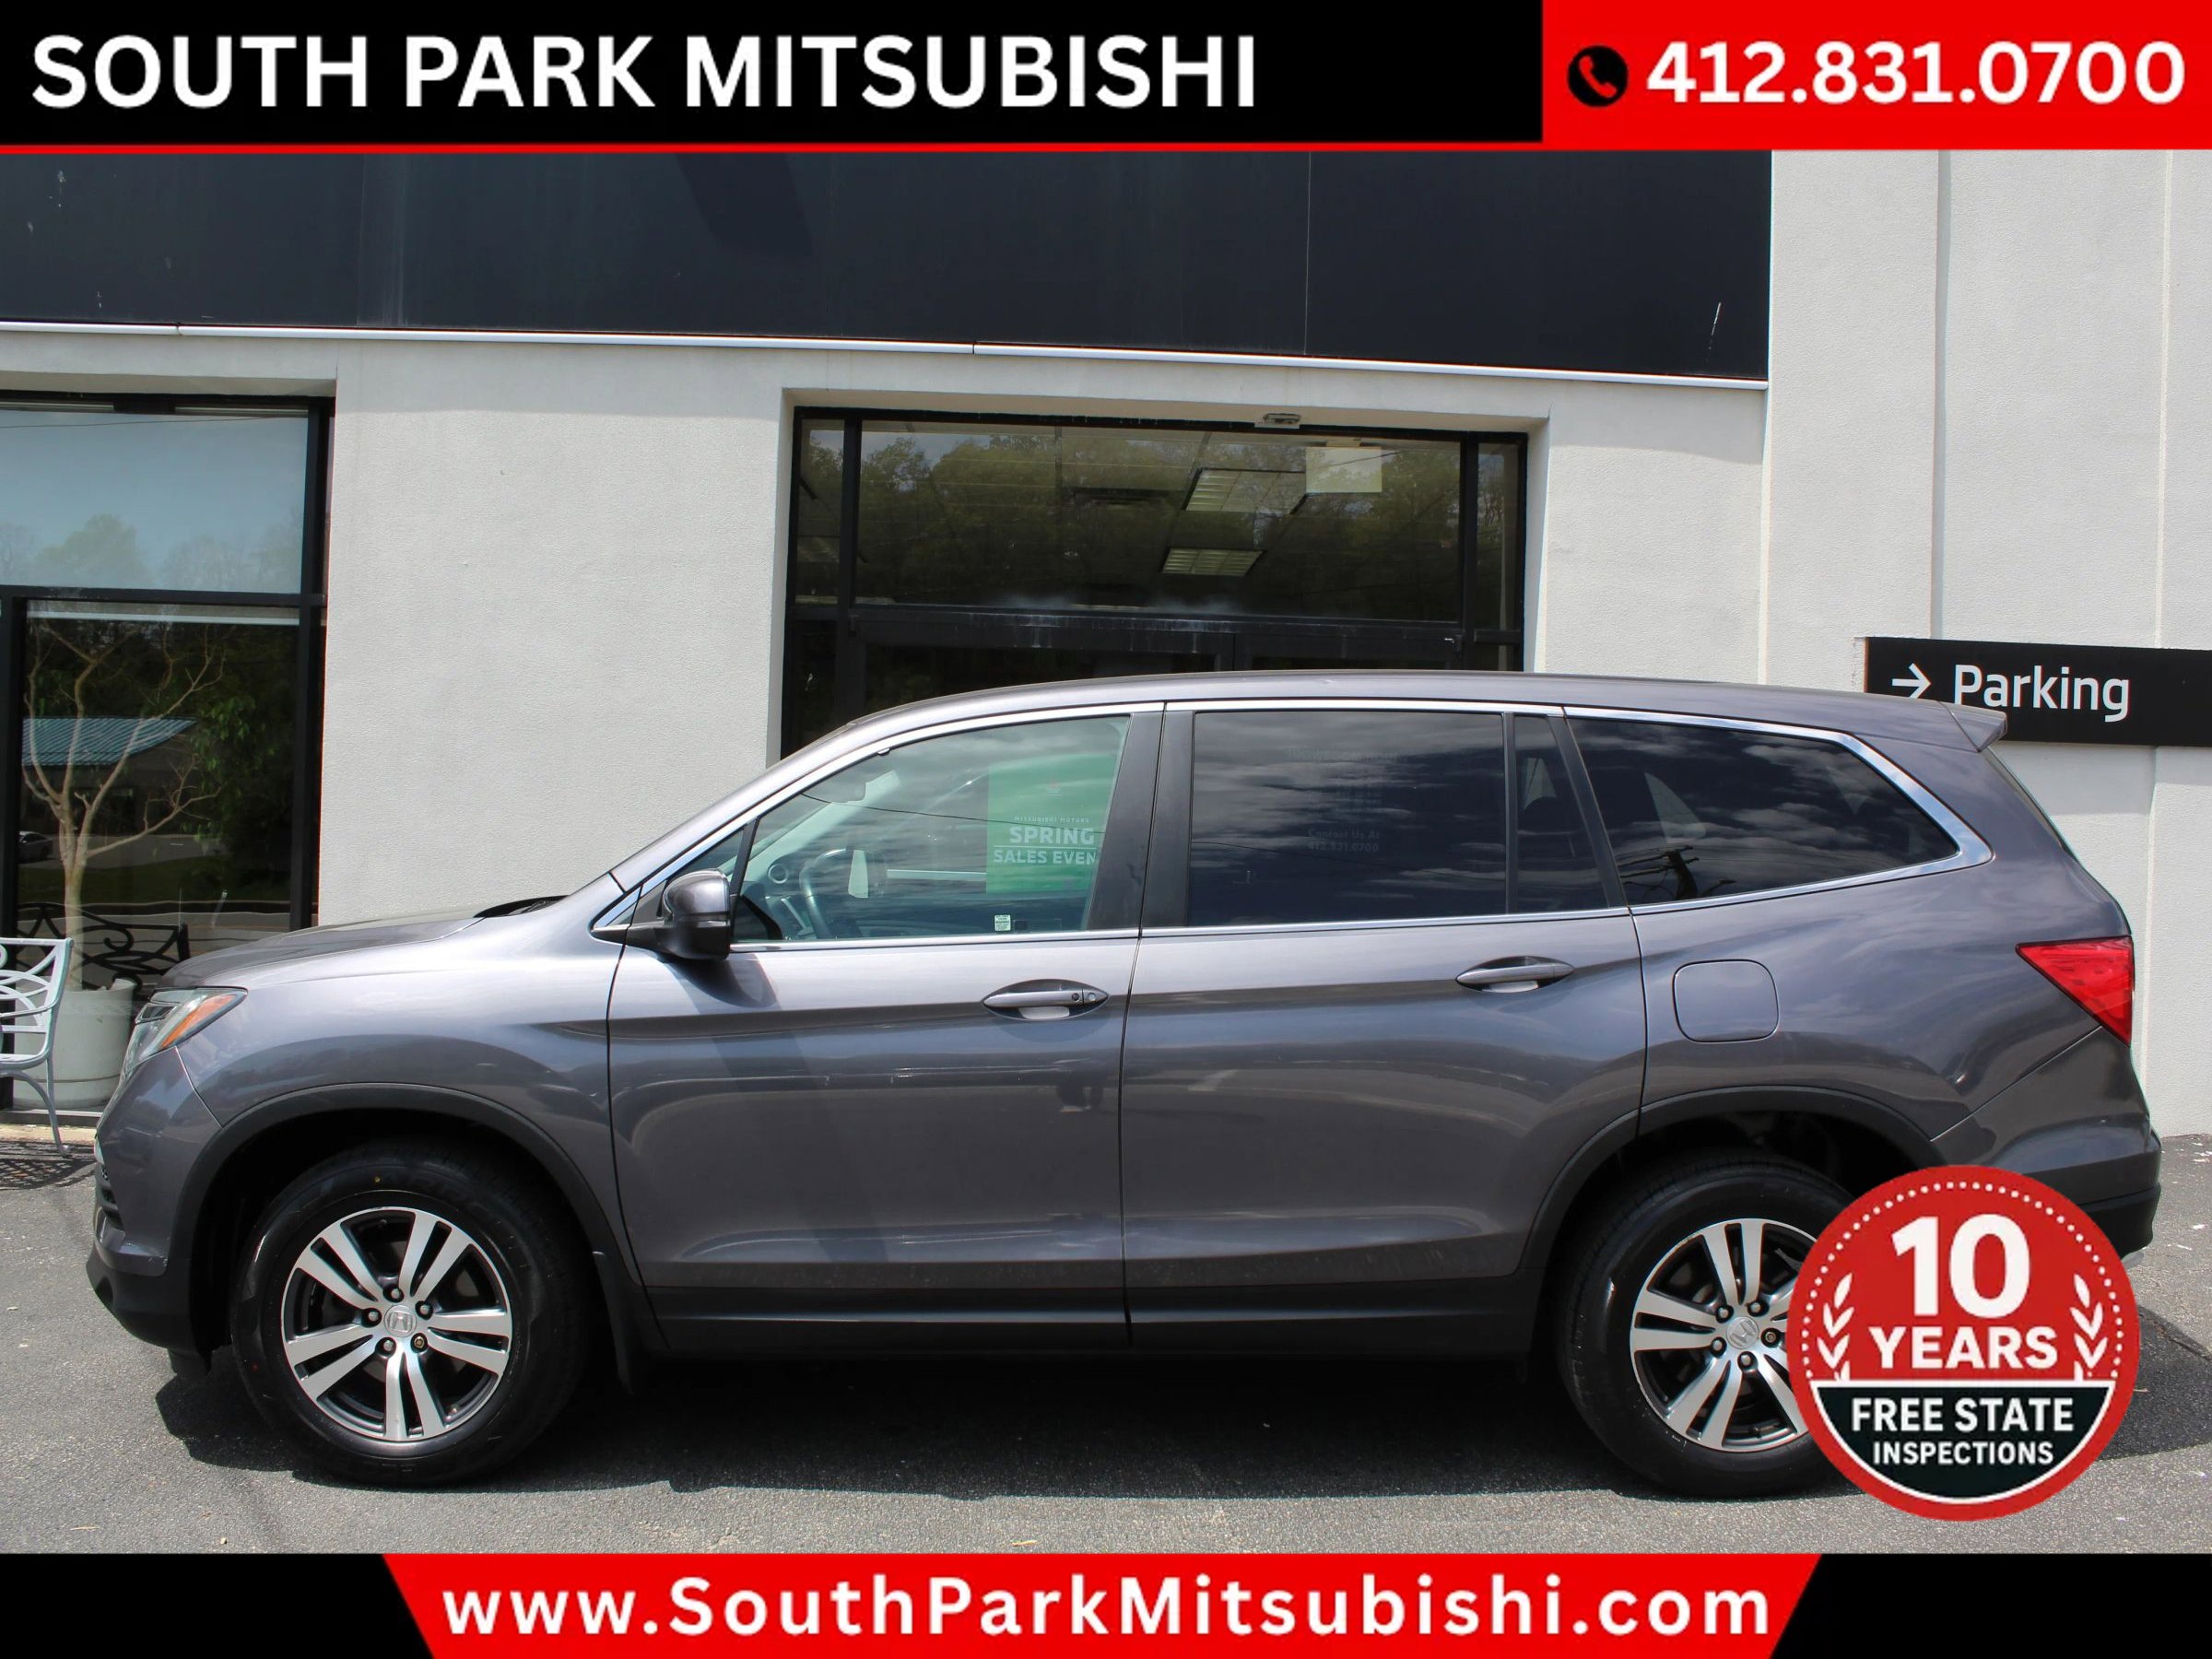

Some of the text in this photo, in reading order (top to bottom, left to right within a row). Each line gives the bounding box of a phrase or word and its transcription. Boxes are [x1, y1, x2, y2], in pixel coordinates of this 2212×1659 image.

[1954, 664, 2130, 723] Parking
[1009, 826, 1095, 845] SPRING
[993, 849, 1047, 864] SALES
